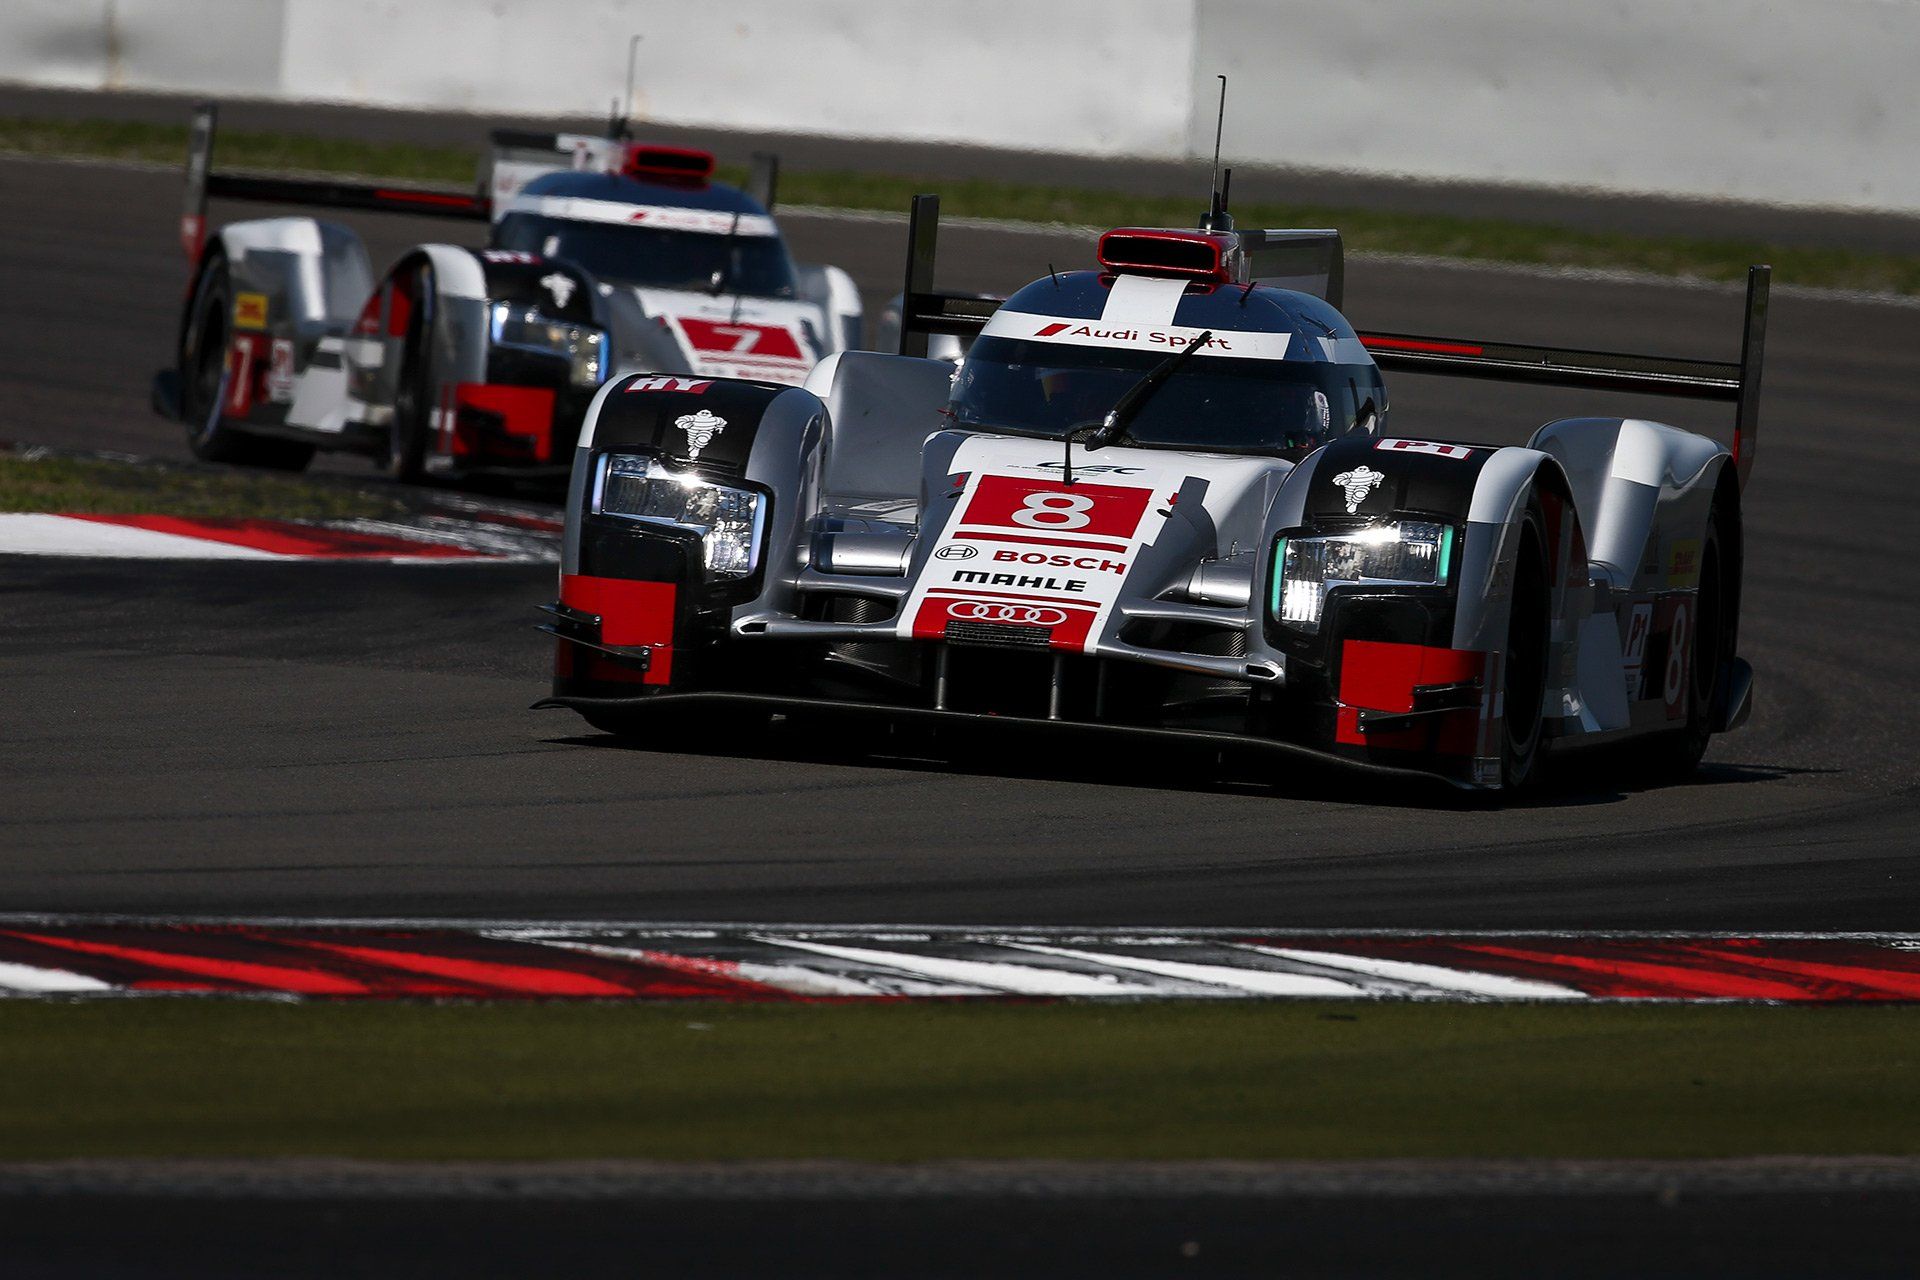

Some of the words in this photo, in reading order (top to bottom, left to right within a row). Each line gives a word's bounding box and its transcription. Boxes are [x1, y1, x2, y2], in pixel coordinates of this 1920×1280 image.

[711, 327, 762, 351] 7
[1071, 326, 1138, 341] Audi
[628, 376, 708, 391] HY
[1393, 441, 1455, 454] P1
[1011, 492, 1095, 530] 8
[992, 549, 1127, 575] BOSCH
[952, 570, 1088, 592] MAHLE
[1664, 603, 1687, 706] 8
